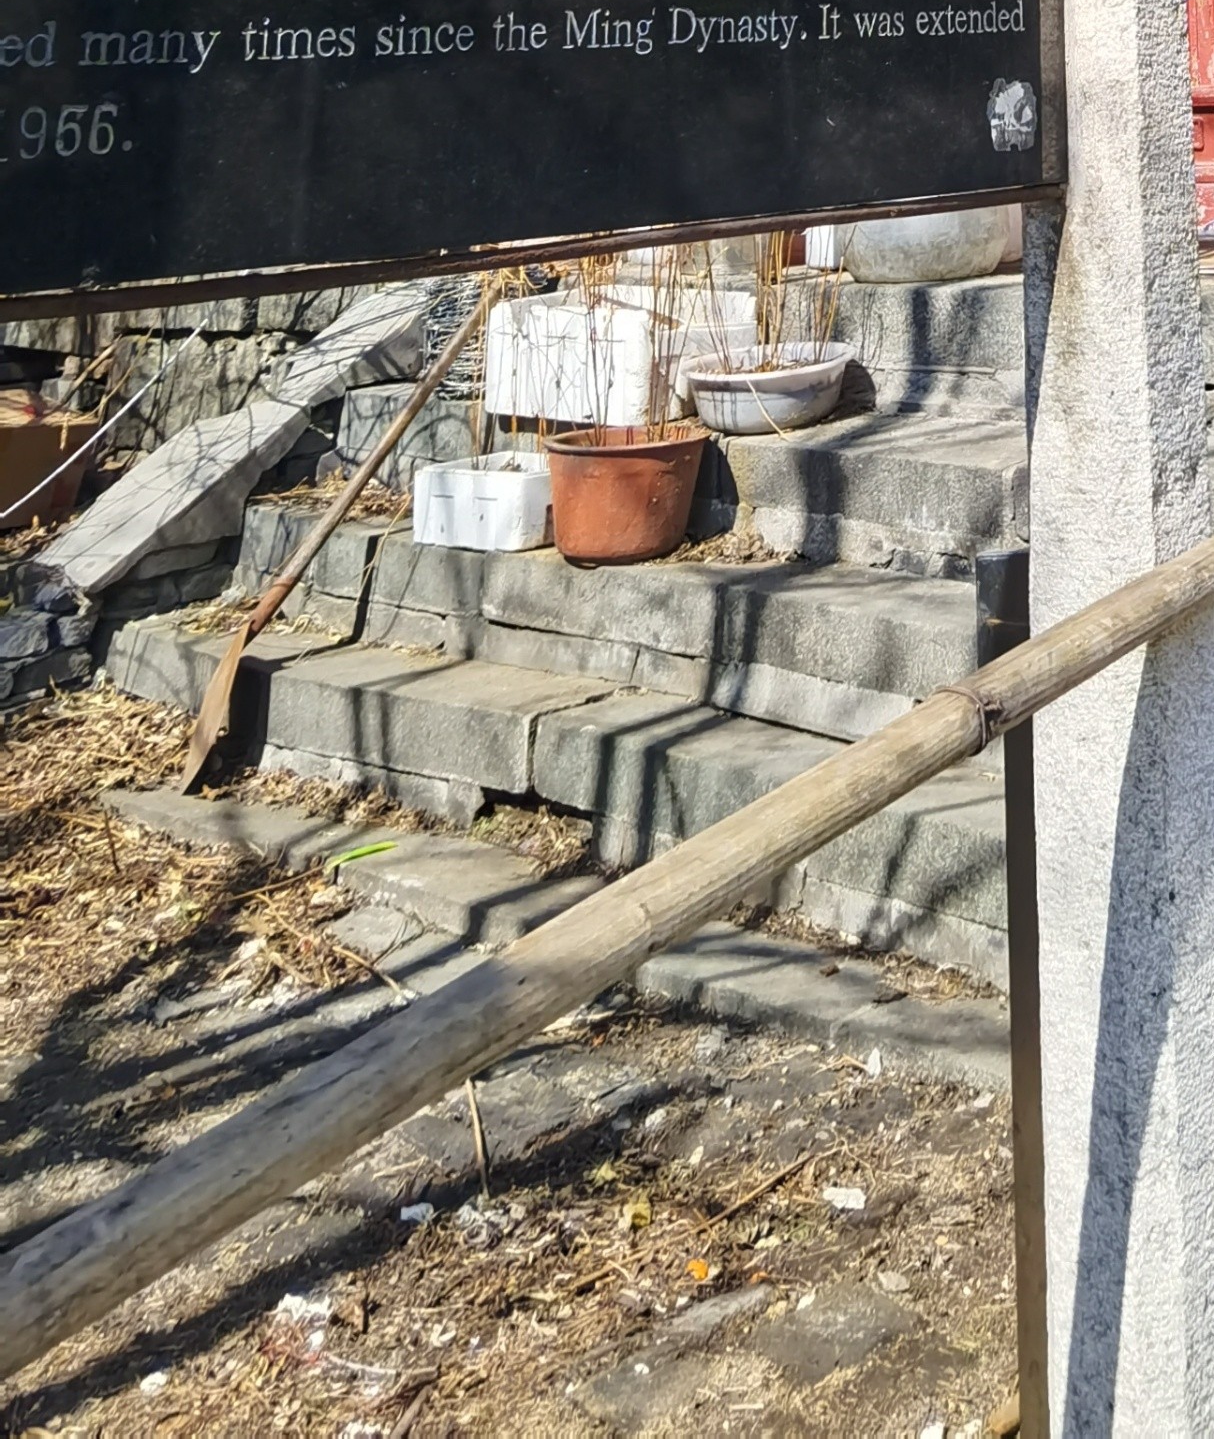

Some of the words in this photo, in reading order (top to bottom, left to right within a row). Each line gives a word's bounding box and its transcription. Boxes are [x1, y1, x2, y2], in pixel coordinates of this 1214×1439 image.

[78, 28, 221, 74] many
[241, 17, 356, 61] times
[375, 15, 475, 57] since
[493, 12, 548, 52] the
[562, 8, 655, 55] Ming
[667, 5, 808, 53] Dynasty.
[818, 3, 842, 40] It
[854, 10, 905, 38] was
[916, 0, 1026, 37] extended
